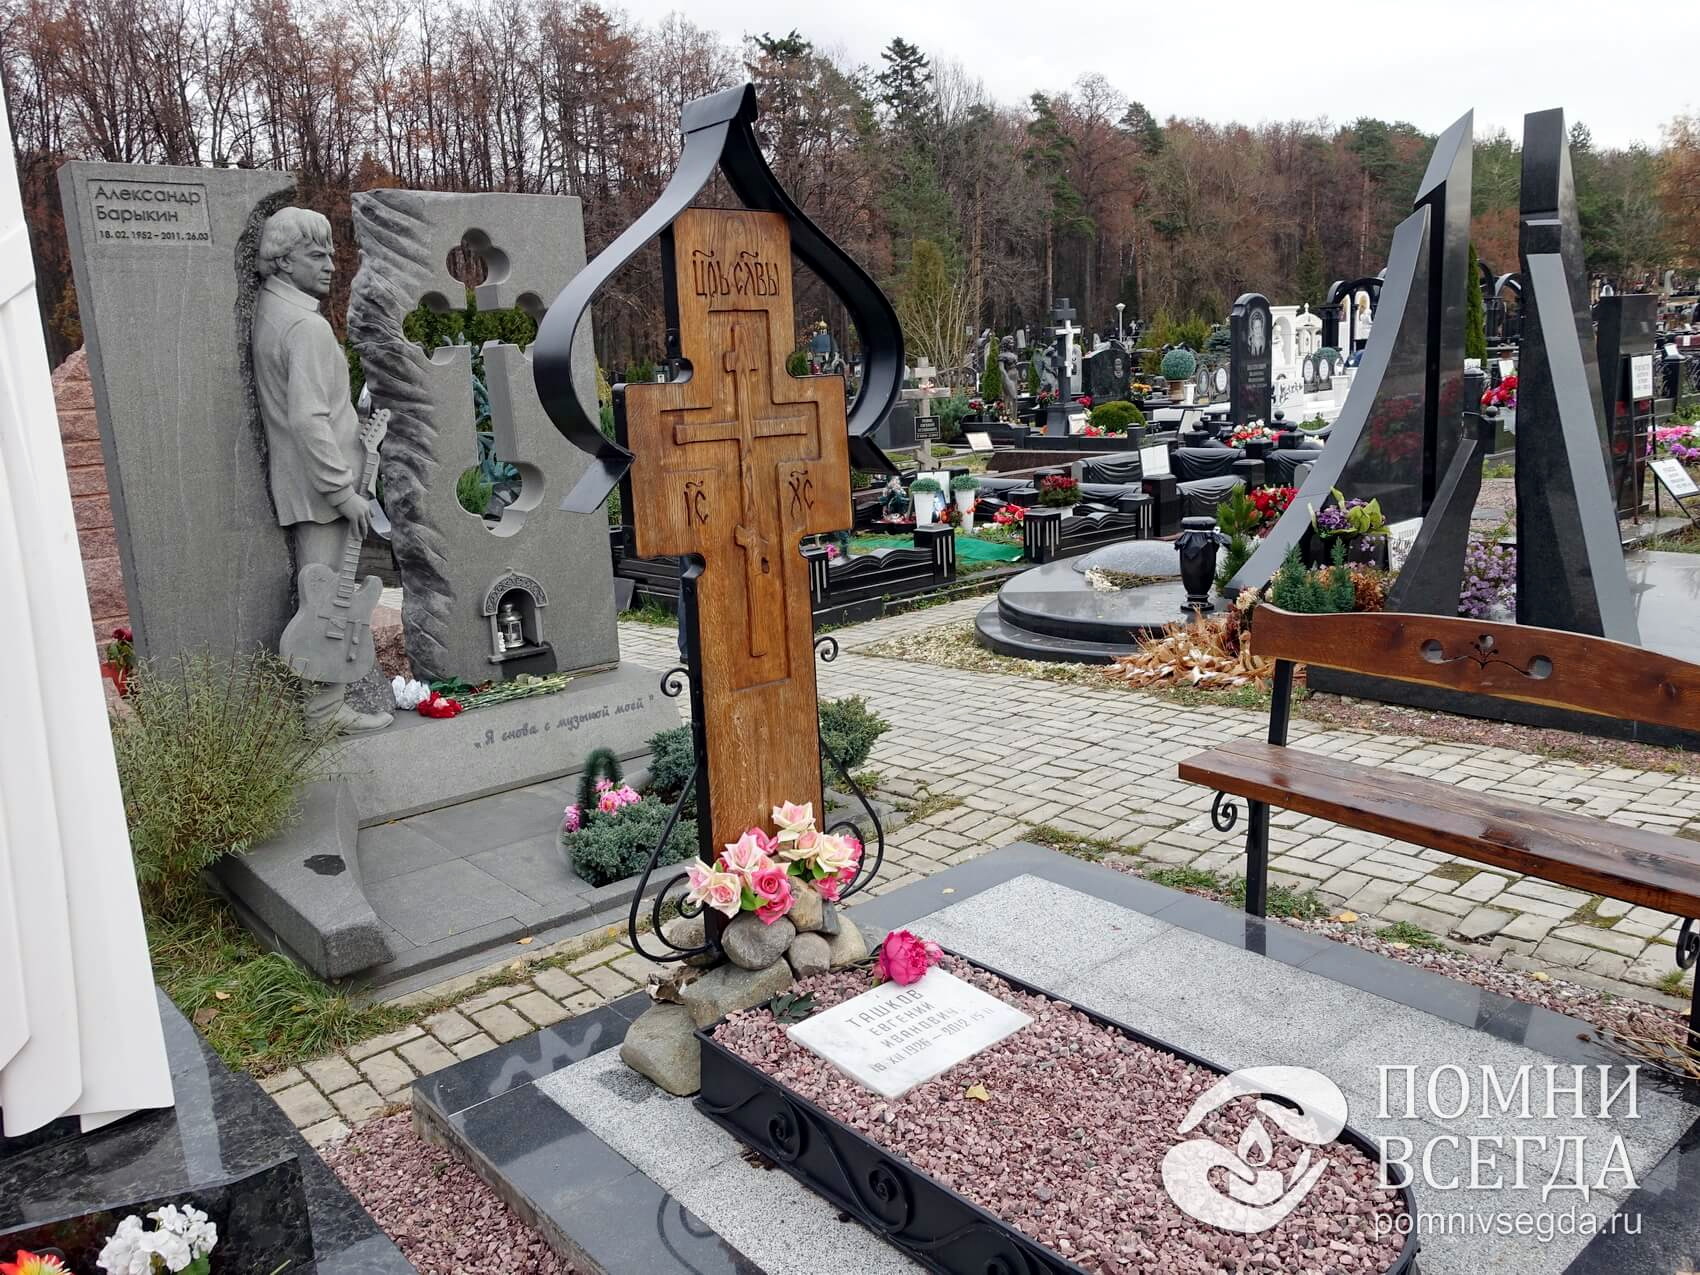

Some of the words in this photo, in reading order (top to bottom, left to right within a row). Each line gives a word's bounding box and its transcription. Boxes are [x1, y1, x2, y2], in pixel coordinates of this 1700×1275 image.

[95, 186, 201, 206] Александр
[96, 205, 178, 223] Барыкин
[502, 723, 539, 742] снова
[544, 722, 551, 732] с
[556, 705, 610, 731] музыкой
[845, 988, 924, 1028] ТАШКОВ
[880, 1007, 960, 1049] ИВАНОВИЧ
